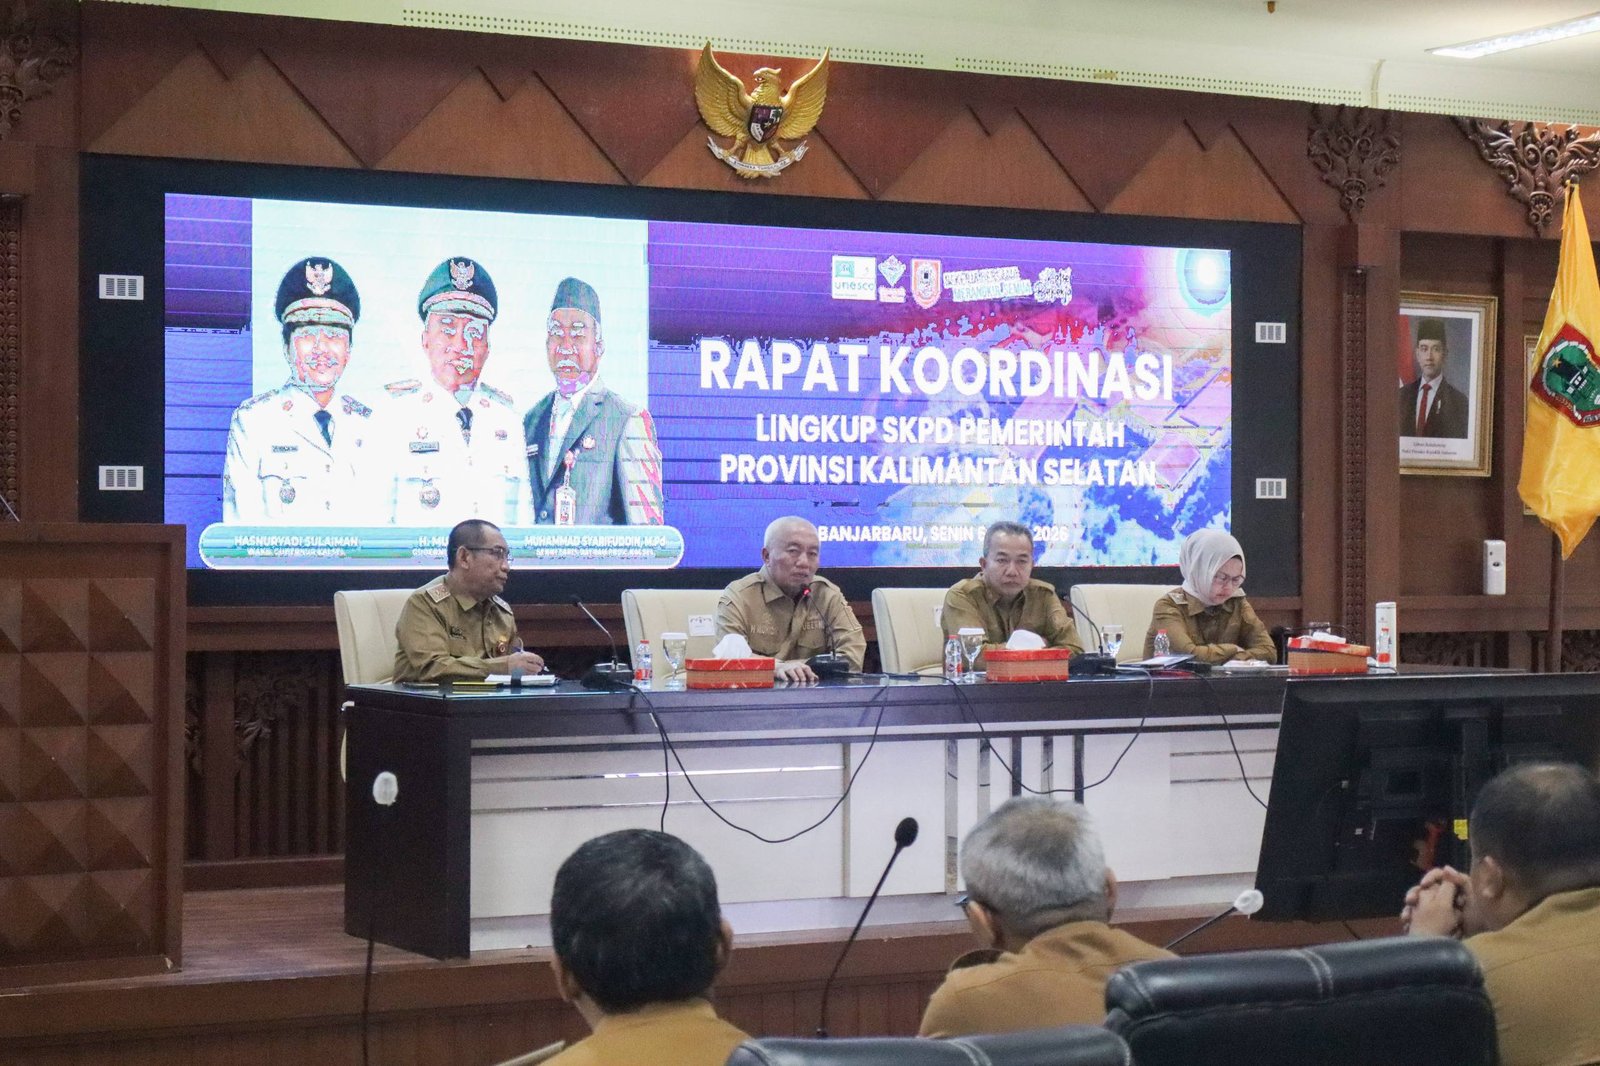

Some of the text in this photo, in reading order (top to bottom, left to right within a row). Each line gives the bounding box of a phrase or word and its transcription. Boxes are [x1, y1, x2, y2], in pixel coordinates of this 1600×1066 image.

[834, 281, 875, 292] unesco
[700, 338, 1173, 401] RAPAT KOORDINASI
[756, 413, 1126, 447] LINGKUP SKPD PEMERINTAH
[720, 453, 1157, 486] PROVINSI KALIMANTAN SELATAN
[306, 536, 359, 547] SULAIMAN
[525, 536, 580, 547] MUHAMMAD
[818, 525, 928, 545] BANJARBARU,
[930, 526, 974, 541] SENIN
[1033, 526, 1069, 541] 2026
